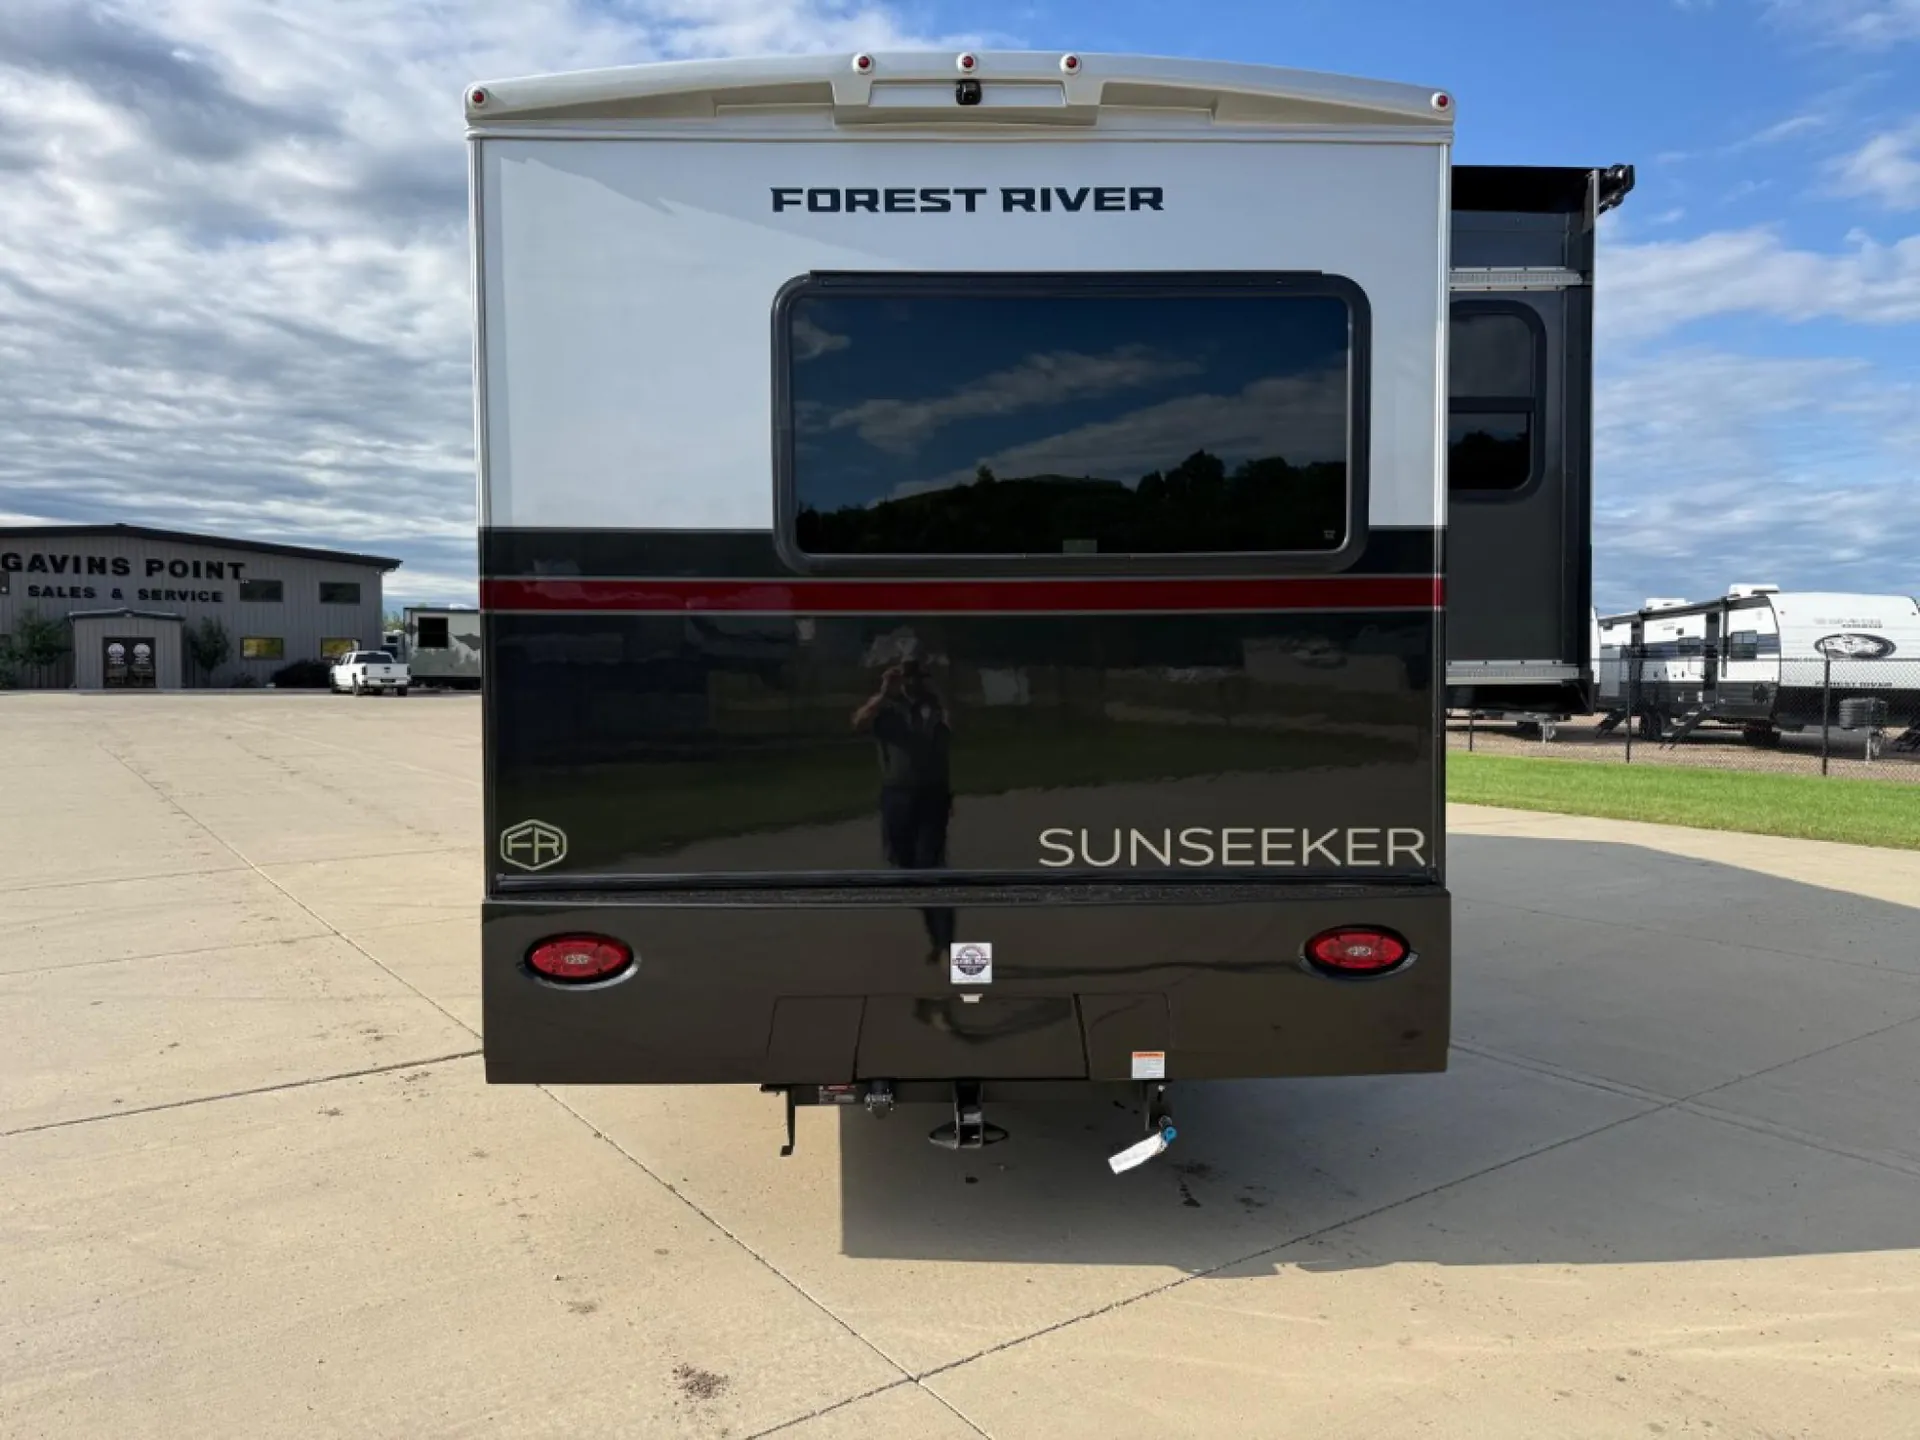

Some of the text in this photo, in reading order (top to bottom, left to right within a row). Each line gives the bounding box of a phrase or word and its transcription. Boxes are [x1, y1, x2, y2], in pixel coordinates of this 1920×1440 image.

[770, 186, 1165, 213] FOREST RIVER
[1, 552, 246, 580] GAVINS POINT
[27, 585, 225, 603] SALES & SERVICE
[506, 825, 561, 865] FR
[1038, 827, 1427, 868] SUNSEEKER
